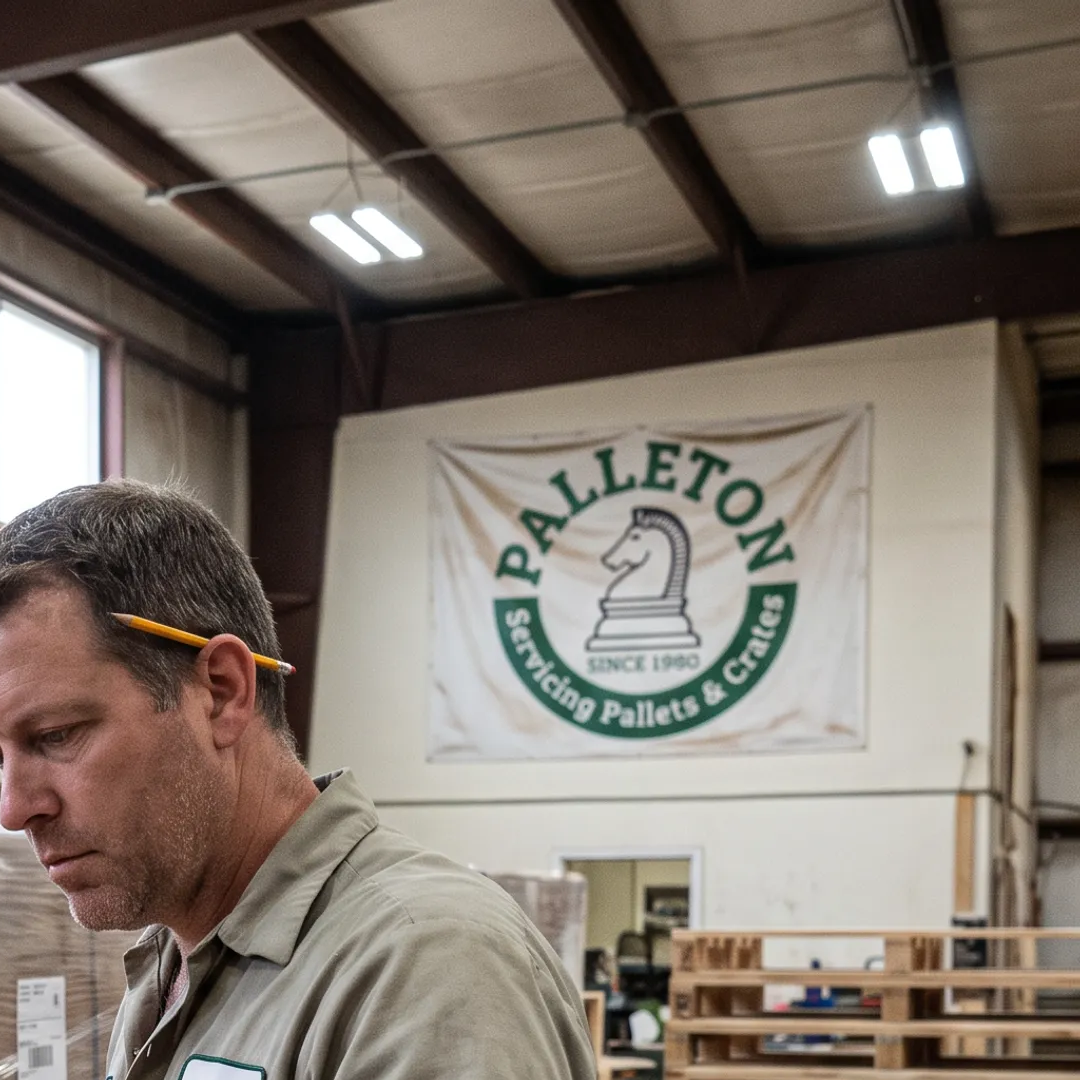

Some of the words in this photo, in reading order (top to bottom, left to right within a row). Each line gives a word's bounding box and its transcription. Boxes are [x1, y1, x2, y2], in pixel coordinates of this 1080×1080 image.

[496, 441, 796, 586] PALLETON
[506, 607, 596, 724] Servicing
[601, 695, 697, 728] Pallets
[703, 680, 725, 707] &
[723, 594, 784, 686] Crates
[587, 656, 645, 674] SINCE
